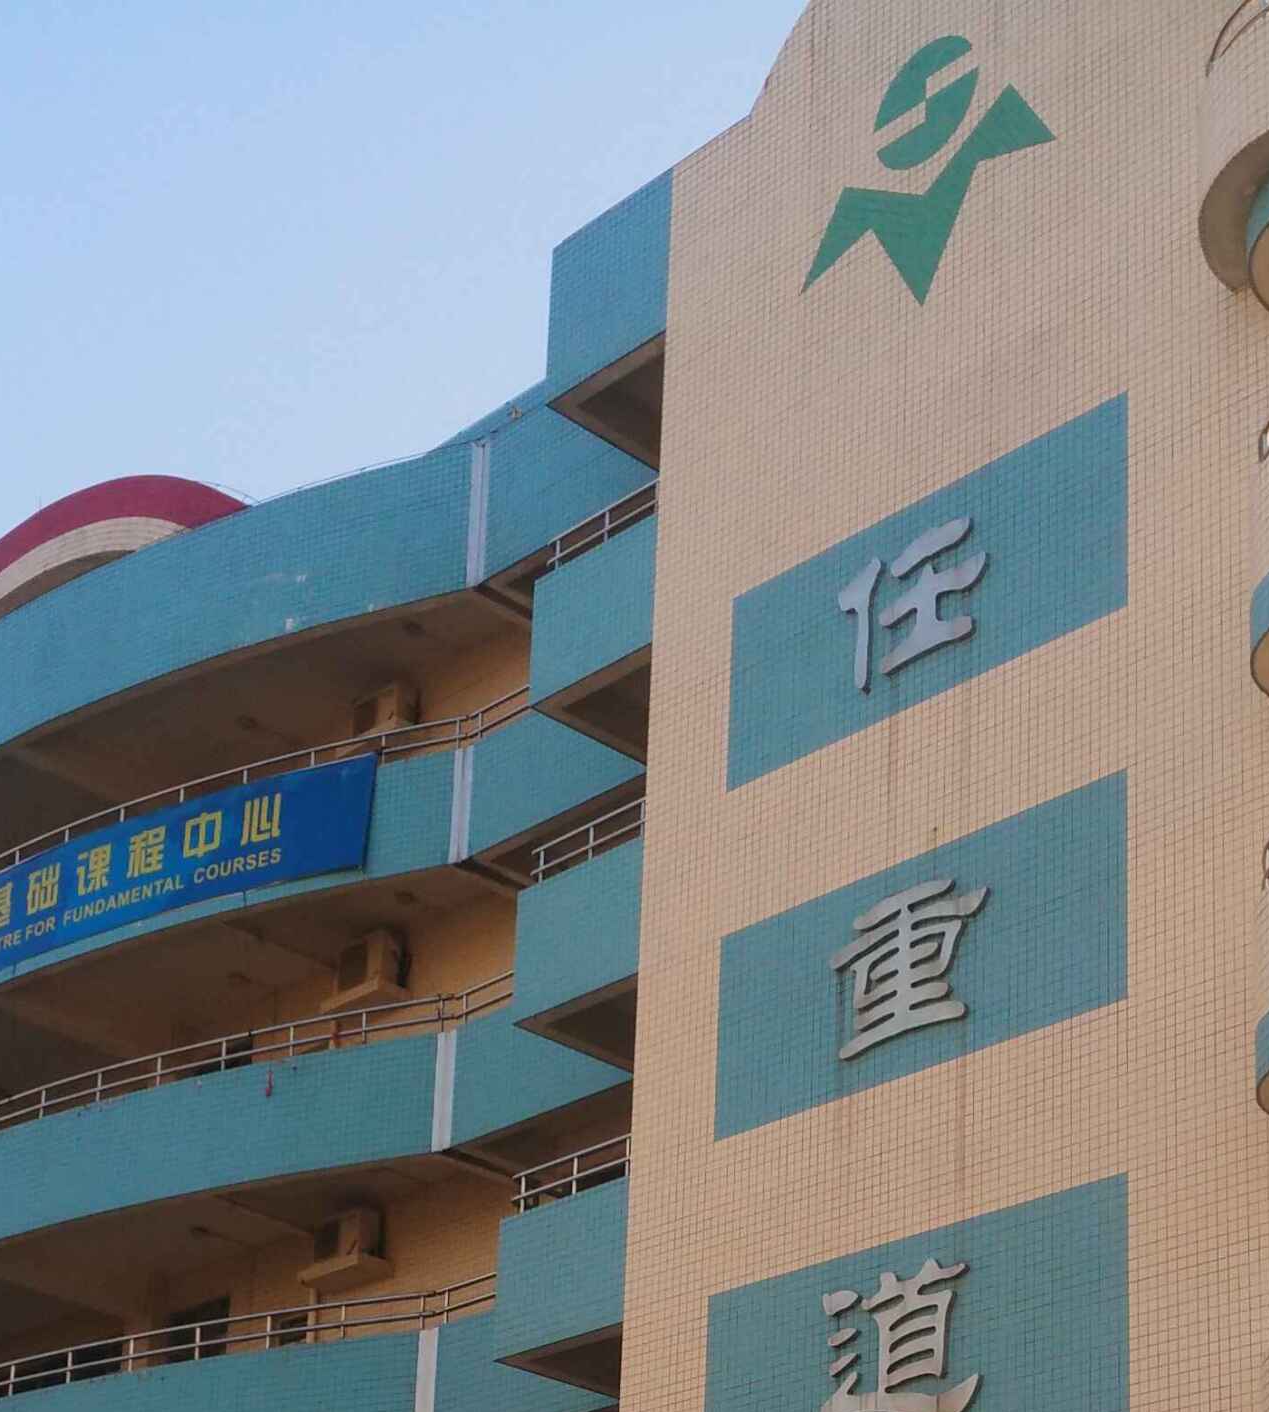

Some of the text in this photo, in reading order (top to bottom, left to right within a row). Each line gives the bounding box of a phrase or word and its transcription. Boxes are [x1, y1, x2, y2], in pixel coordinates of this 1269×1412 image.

[25, 916, 56, 941] FOR
[62, 874, 184, 928] FUNDAMENTAL
[193, 848, 282, 884] COURSES
